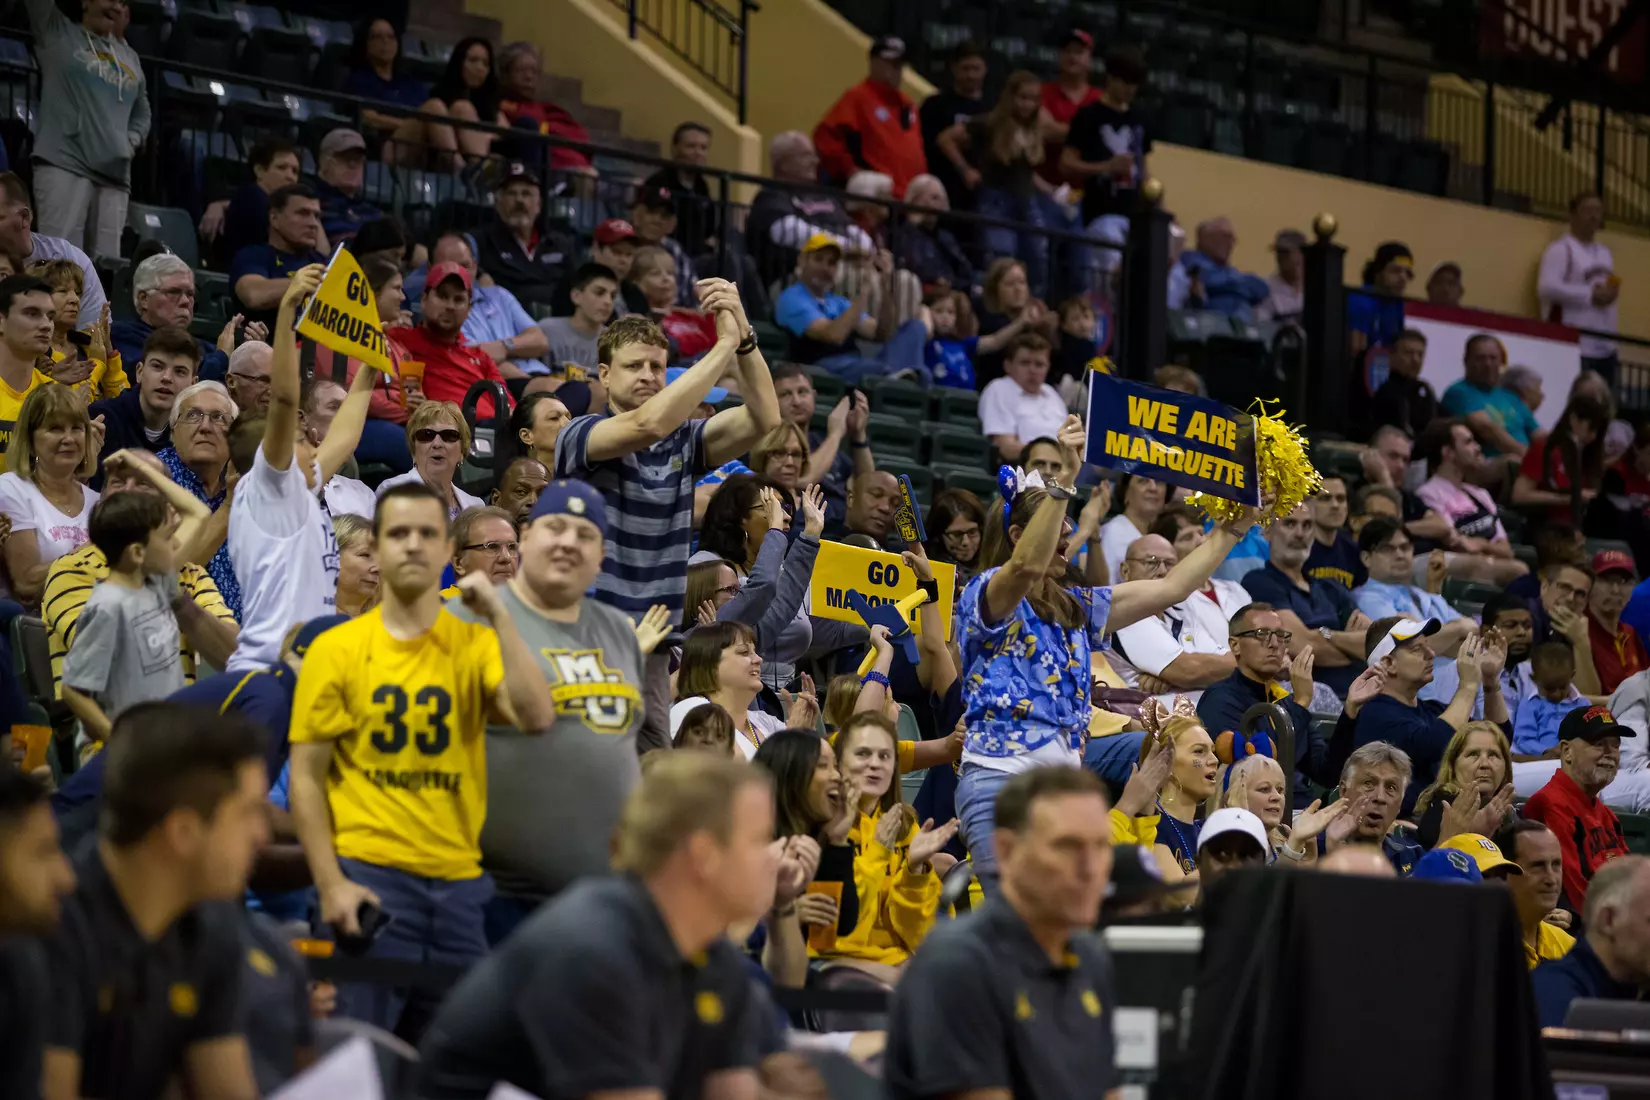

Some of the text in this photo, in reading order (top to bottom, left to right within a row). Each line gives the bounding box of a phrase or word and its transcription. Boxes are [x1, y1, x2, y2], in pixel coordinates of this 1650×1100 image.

[347, 271, 369, 306] GO
[308, 299, 389, 358] MARQUETT
[1128, 395, 1237, 451] WE ARE
[1105, 429, 1245, 489] MARQUETTE
[868, 561, 900, 588] GO
[371, 683, 452, 755] 33
